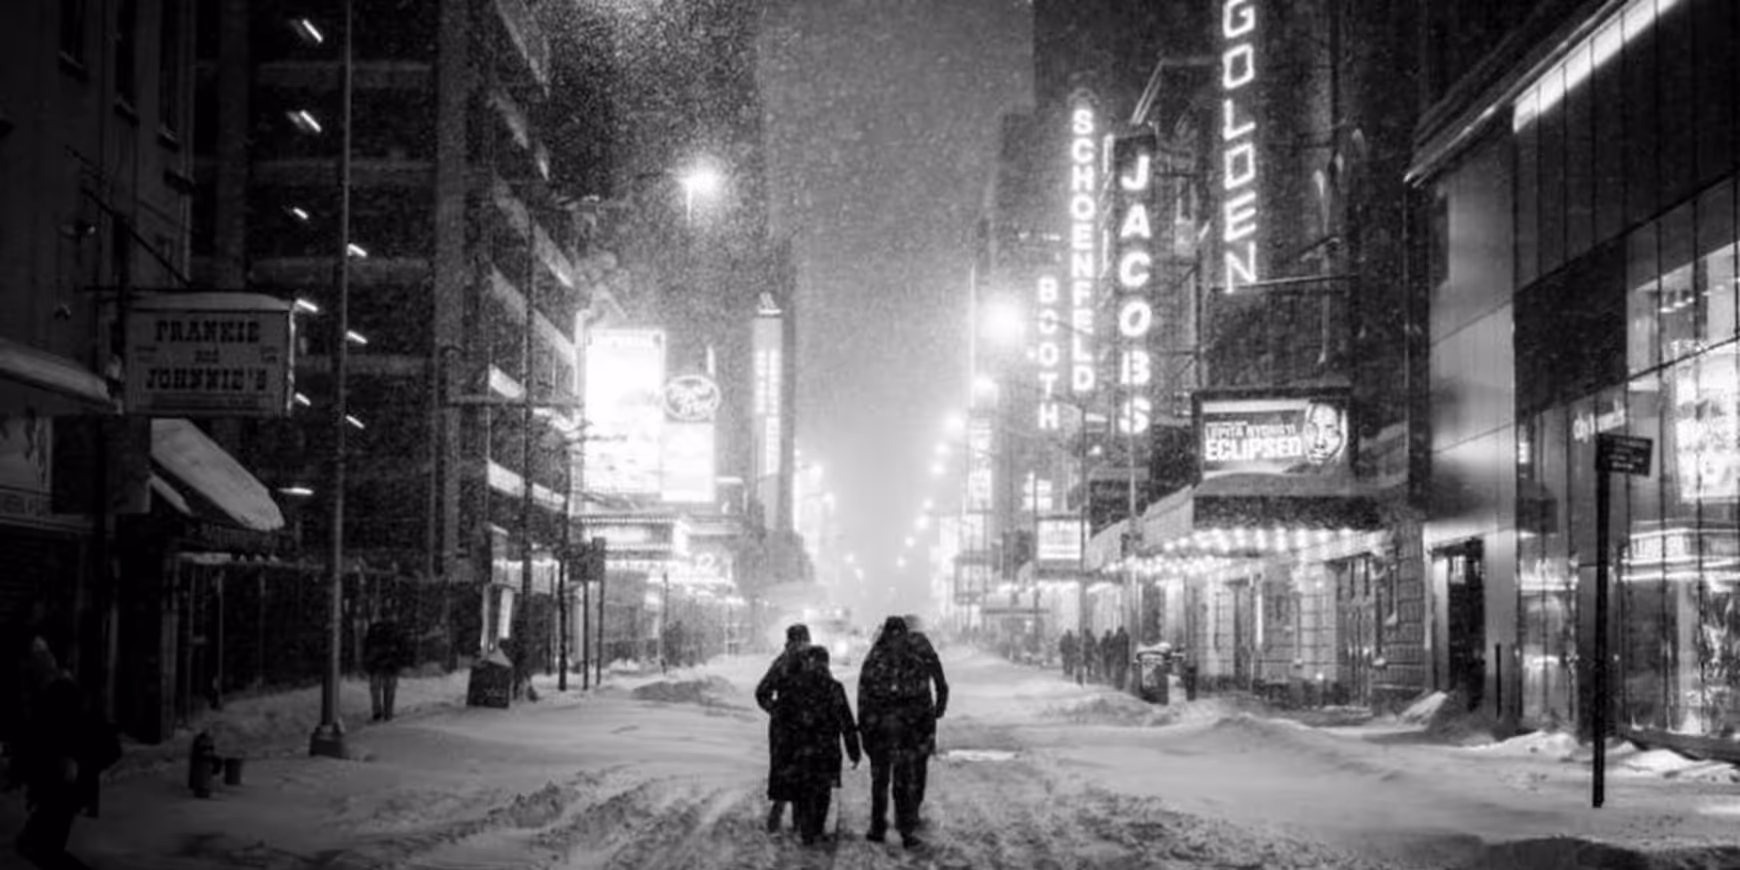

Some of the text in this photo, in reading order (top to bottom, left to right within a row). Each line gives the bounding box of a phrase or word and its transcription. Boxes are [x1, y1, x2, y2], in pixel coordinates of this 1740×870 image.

[1222, 0, 1257, 294] GOLDEN
[1070, 107, 1095, 392] SCHOENFELD
[1118, 153, 1151, 436] JACOBS
[145, 367, 268, 391] JOHNNIE'S
[154, 319, 261, 343] FRANKIE
[1037, 276, 1060, 431] BOOTH
[1204, 436, 1303, 461] ECLIPSED
